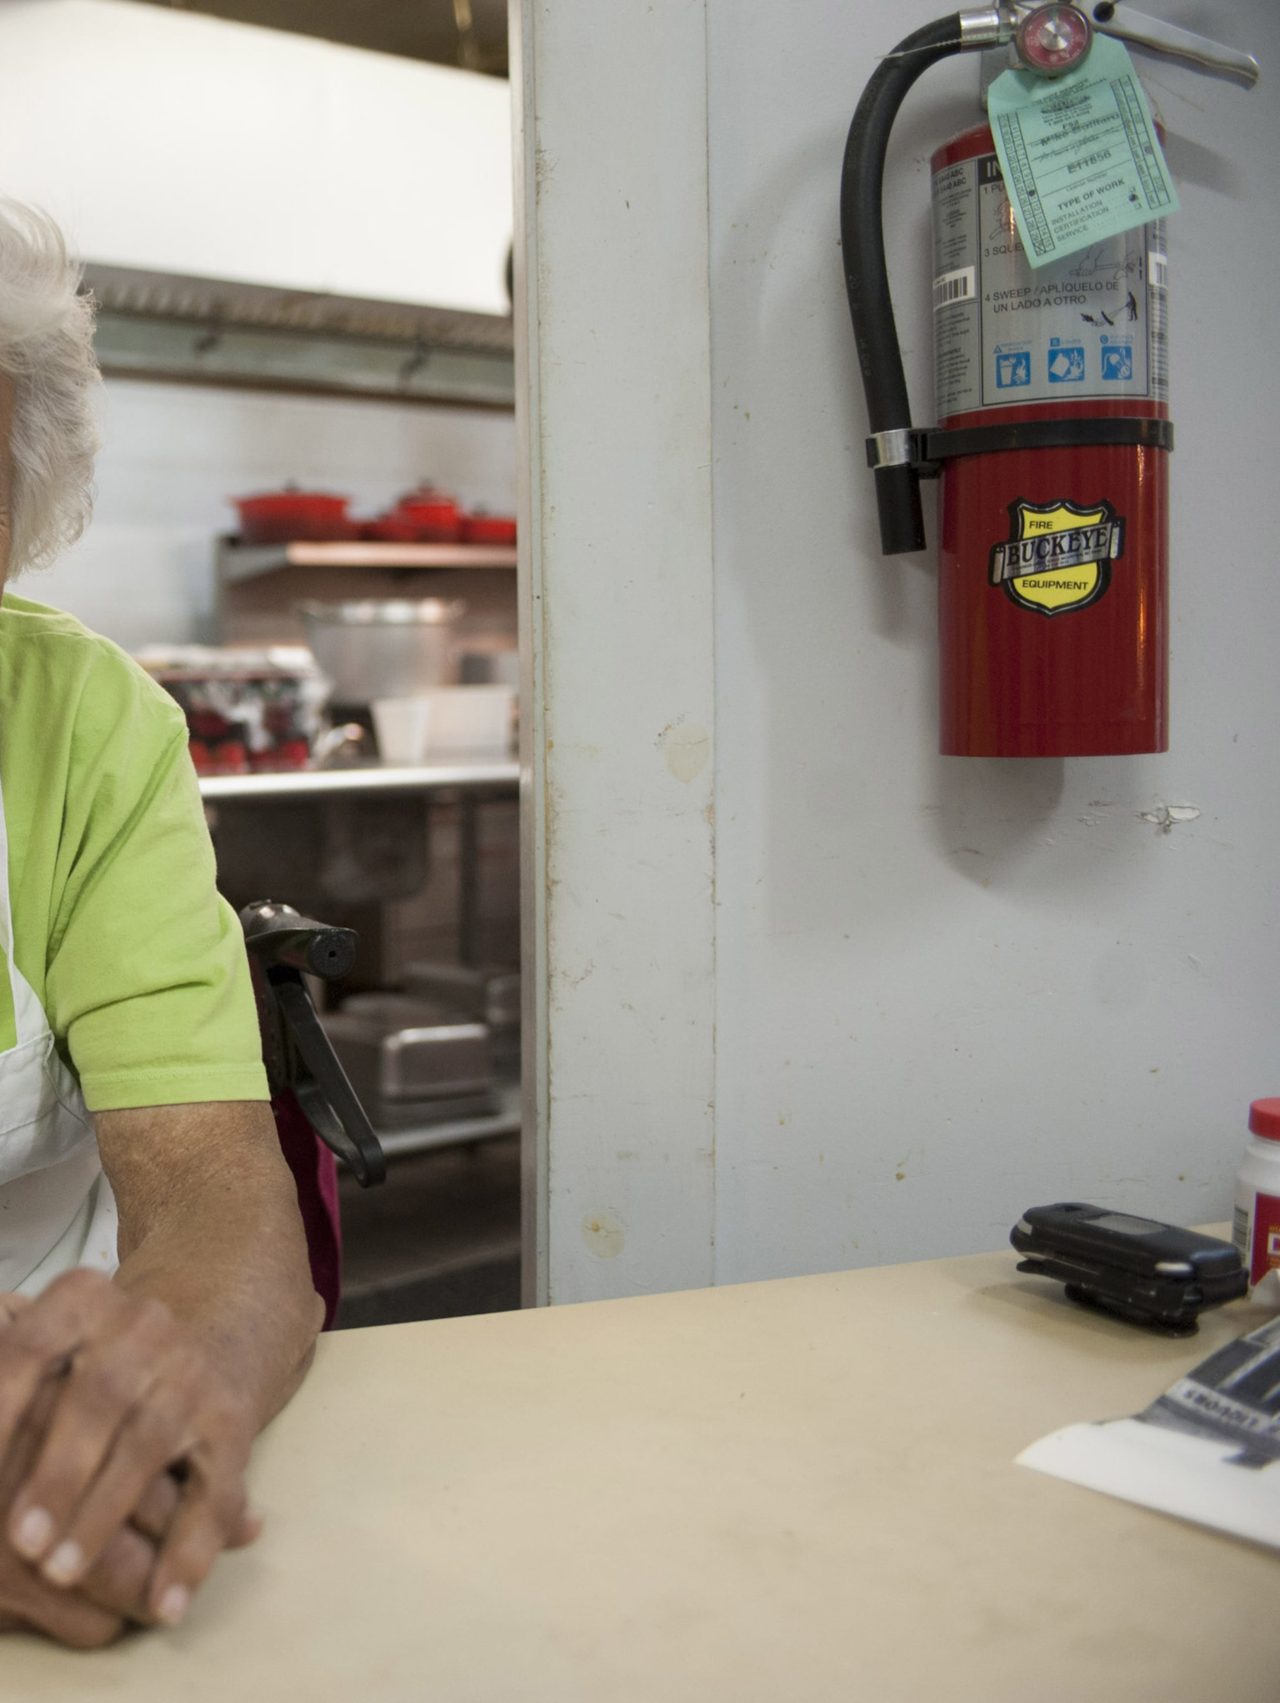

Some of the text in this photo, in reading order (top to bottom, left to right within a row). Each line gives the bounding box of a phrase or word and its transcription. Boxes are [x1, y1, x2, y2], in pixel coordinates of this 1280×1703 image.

[1057, 178, 1125, 211] TYPE OF WORK
[1052, 200, 1103, 226] INSTALLATION
[1054, 207, 1109, 234] CERTIFICATION
[1057, 225, 1089, 242] SERVICE
[984, 248, 990, 257] 3
[985, 294, 990, 302] 4
[993, 287, 1032, 301] SWEEP
[1040, 281, 1103, 296] APLÍQUELO
[1106, 281, 1119, 291] DE
[993, 294, 1087, 314] UN LADO A OTRO
[1029, 520, 1053, 530] FIRE
[1006, 527, 1108, 567] BUCKEYE
[1022, 579, 1089, 590] EQUIPMENT
